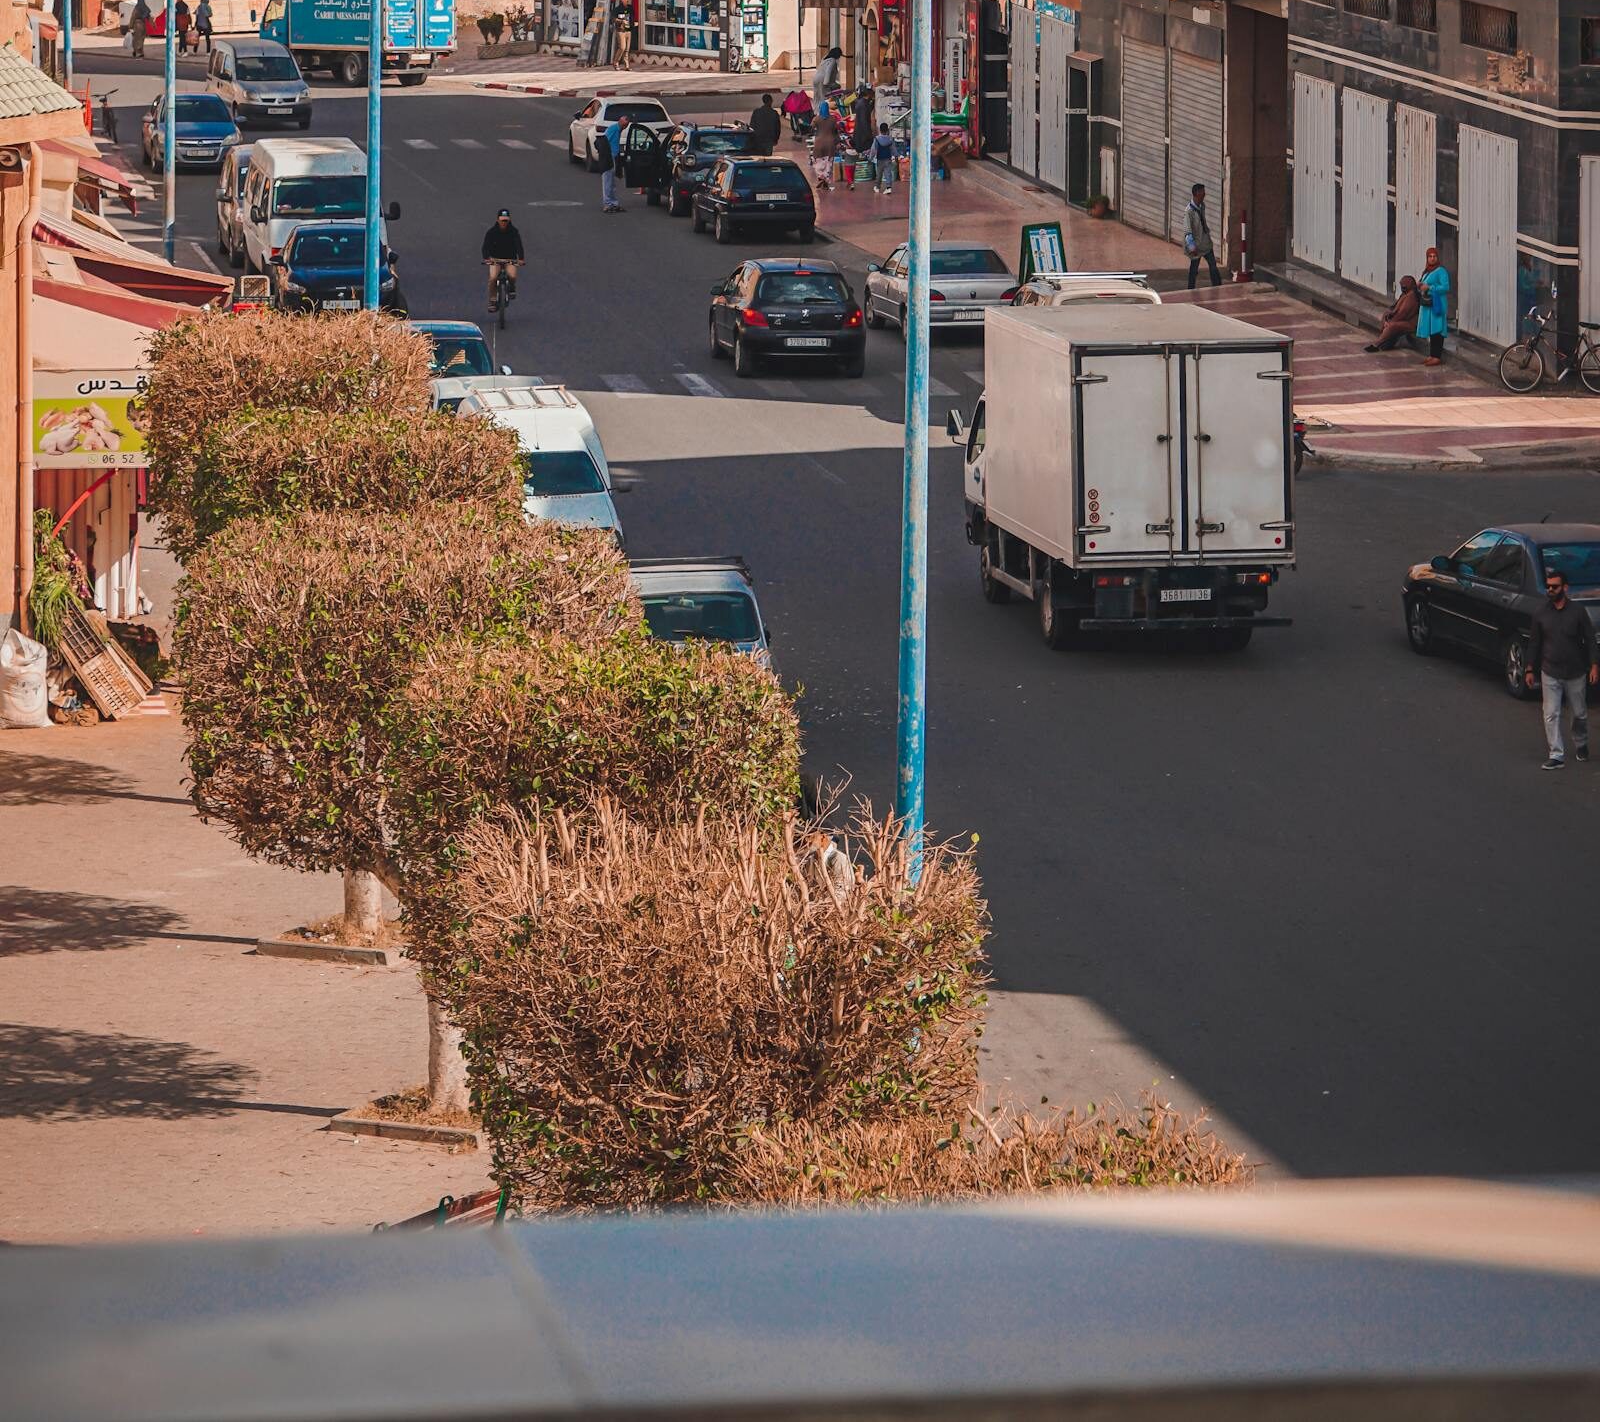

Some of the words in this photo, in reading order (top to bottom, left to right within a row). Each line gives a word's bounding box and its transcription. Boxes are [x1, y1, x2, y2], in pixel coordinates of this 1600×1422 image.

[77, 375, 149, 395] قدس
[102, 454, 115, 464] 06
[122, 454, 134, 464] 52
